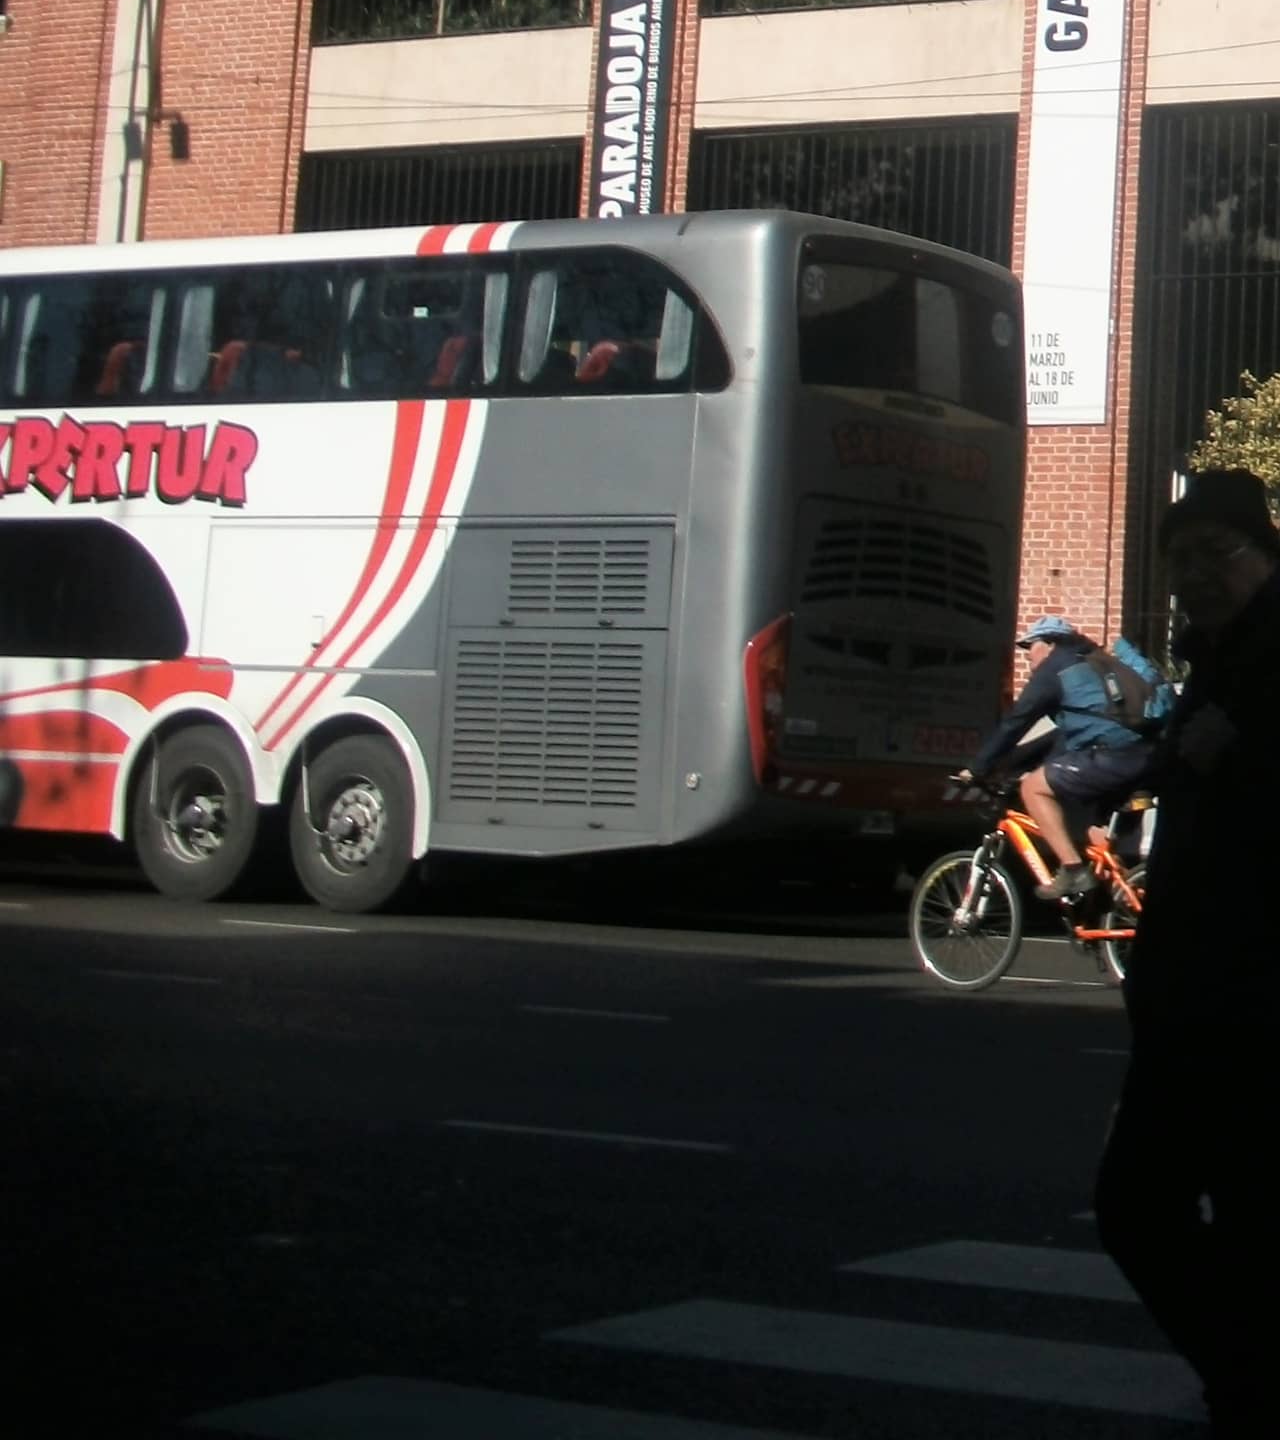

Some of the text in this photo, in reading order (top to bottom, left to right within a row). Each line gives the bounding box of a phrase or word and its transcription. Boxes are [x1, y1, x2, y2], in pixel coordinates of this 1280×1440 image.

[648, 22, 662, 62] BUENOS
[648, 64, 659, 80] DE
[599, 3, 648, 219] PARADOJA
[643, 135, 657, 162] ARTE
[644, 163, 654, 177] DE
[639, 178, 652, 215] MUSEO
[1031, 333, 1060, 348] 11 DE
[1029, 352, 1066, 367] MARZO
[1028, 371, 1075, 386] AL 18 DE
[1026, 390, 1059, 406] JUNIO
[0, 411, 258, 509] PERTUR
